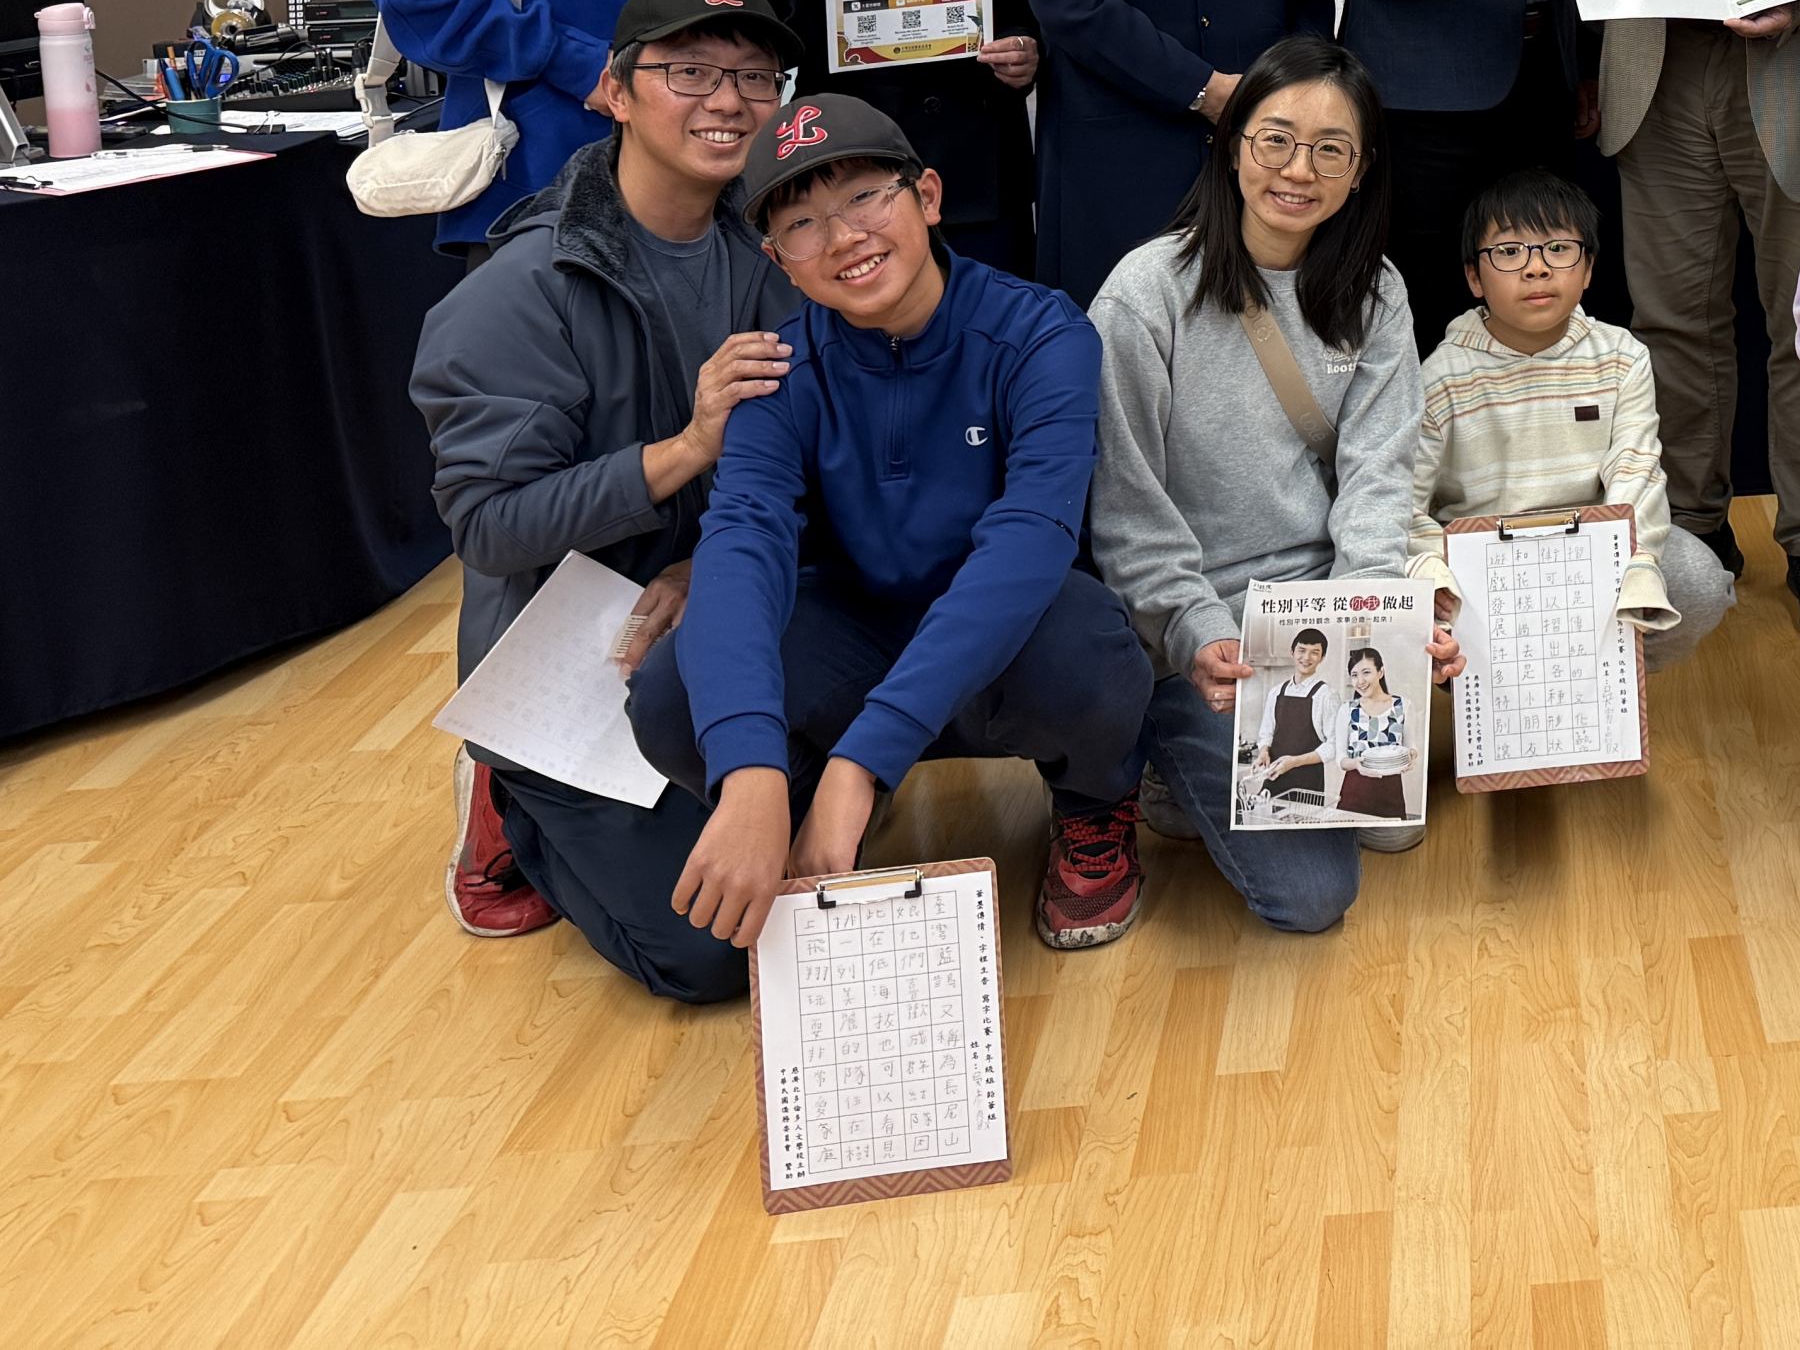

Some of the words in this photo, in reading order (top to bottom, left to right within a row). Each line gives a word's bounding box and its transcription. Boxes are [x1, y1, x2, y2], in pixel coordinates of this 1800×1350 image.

[1261, 597, 1326, 614] 性別平等
[1333, 595, 1413, 611] 從你我做起
